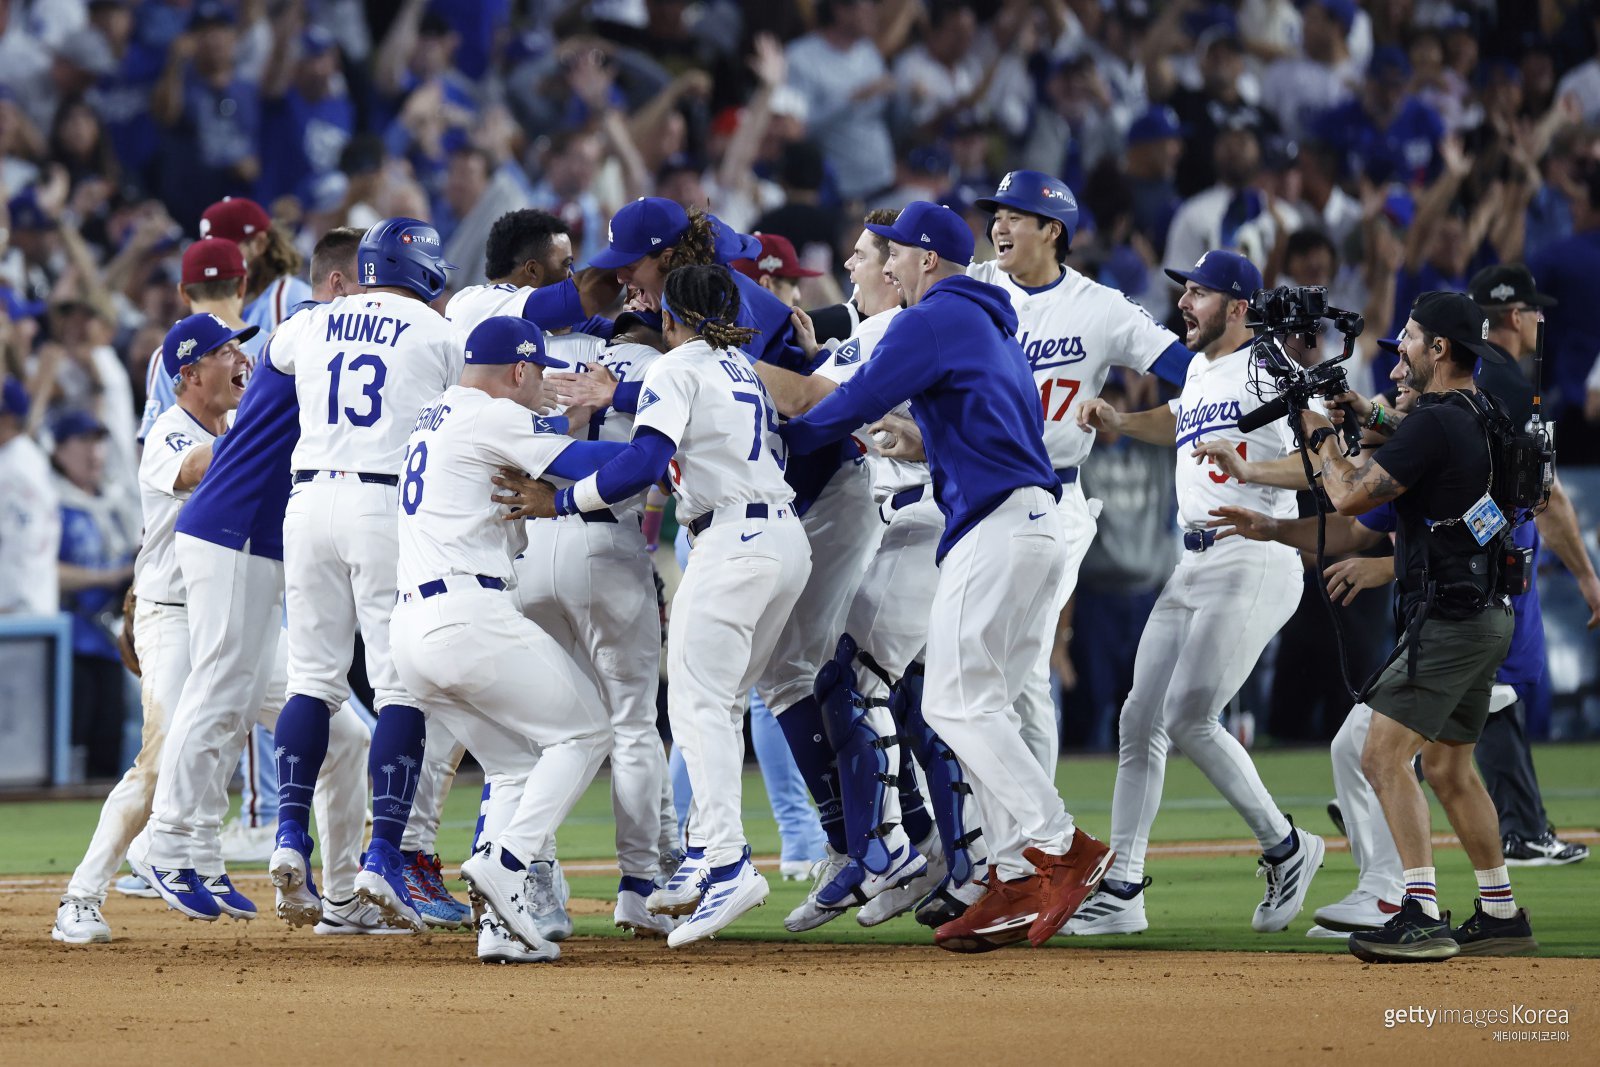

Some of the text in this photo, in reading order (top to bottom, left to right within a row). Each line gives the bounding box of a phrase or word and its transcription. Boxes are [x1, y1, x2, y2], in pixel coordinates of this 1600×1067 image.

[412, 235, 440, 247] STRAUSS
[364, 262, 375, 276] 13
[326, 313, 411, 347] MUNCY
[1020, 331, 1086, 371] gers
[327, 352, 387, 427] 13
[1040, 378, 1081, 421] 17
[732, 391, 786, 471] 75
[399, 441, 428, 516] 8
